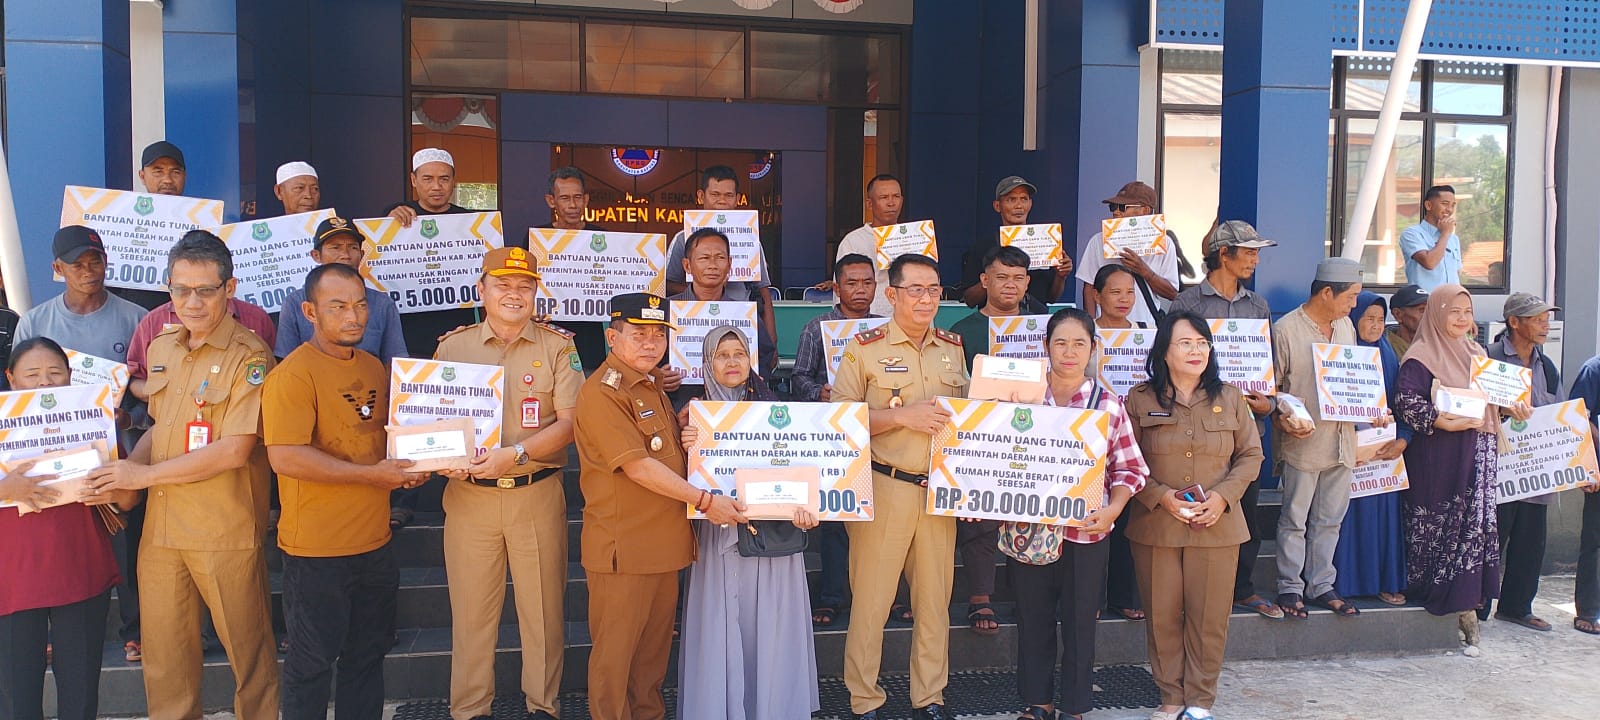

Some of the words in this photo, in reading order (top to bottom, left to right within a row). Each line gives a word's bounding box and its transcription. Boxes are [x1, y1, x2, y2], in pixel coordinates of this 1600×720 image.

[84, 213, 133, 225] BANTUAN
[136, 219, 166, 228] UANG
[582, 207, 649, 223] UPATEN
[124, 232, 156, 240] DAERAH
[112, 245, 140, 254] RUSAK
[142, 248, 169, 256] RINGA
[260, 241, 289, 252] UANG
[377, 243, 424, 253] BANTUAN
[426, 241, 453, 250] UANG
[455, 238, 484, 247] TUNAI
[119, 253, 156, 263] SEBESAR
[367, 256, 416, 266] PEMERINTAH
[417, 255, 447, 263] DAERAH
[548, 253, 592, 263] BANTUAN
[594, 255, 619, 263] UANG
[621, 256, 648, 265] TUNAI
[377, 272, 407, 281] RUMAH
[409, 271, 435, 279] RUSAK
[537, 267, 583, 275] PEMERINTAH
[584, 268, 612, 276] DAERAH
[245, 273, 274, 284] RUSAK
[256, 276, 291, 288] SEBESAR
[418, 276, 451, 285] SEBESAR
[601, 282, 631, 290] SEDANG
[677, 317, 709, 327] BANTUAN
[996, 333, 1027, 344] BANTUAN
[1247, 335, 1266, 343] TUNAI
[1104, 347, 1134, 356] BANTUAN
[400, 382, 441, 394] BANTUAN
[443, 385, 467, 396] UANG
[469, 386, 494, 398] TUNAI
[46, 410, 72, 424] UANG
[74, 407, 104, 420] TUNAI
[398, 404, 434, 415] PEMERINTAH
[435, 406, 457, 416] DAERAH
[472, 408, 495, 418] KAPUAS
[40, 434, 66, 447] DAERAH
[66, 433, 82, 443] KAB.
[82, 430, 108, 441] KAPUAS
[713, 432, 771, 442] BANTUAN
[774, 432, 808, 442] UANG
[811, 433, 846, 442] TUNAI
[1517, 431, 1543, 442] UANG
[1544, 425, 1572, 437] TUNAI
[957, 431, 1012, 444] BANTUAN
[1014, 436, 1047, 447] UANG
[1050, 438, 1084, 450] TUNAI
[1556, 436, 1584, 446] KAPUAS
[699, 449, 759, 458] PEMERINTAH
[761, 450, 798, 458] DAERAH
[800, 450, 822, 458] KAB.
[823, 450, 860, 458] KAPUAS
[942, 447, 999, 459] PEMERINTAH
[1000, 452, 1036, 463] DAERAH
[1038, 455, 1059, 465] KAB.
[1060, 457, 1096, 467] KAPUAS
[1505, 460, 1530, 470] RUSAK
[1531, 454, 1560, 466] SEDANG
[714, 467, 737, 475] RUM
[827, 468, 840, 476] RB
[955, 466, 990, 478] RUMAH
[992, 469, 1023, 480] RUSAK
[1025, 472, 1054, 482] BERAT
[1062, 475, 1074, 484] RB
[1514, 464, 1545, 475] SEBESAR
[997, 479, 1036, 489] SEBESAR
[935, 486, 963, 511] RP.
